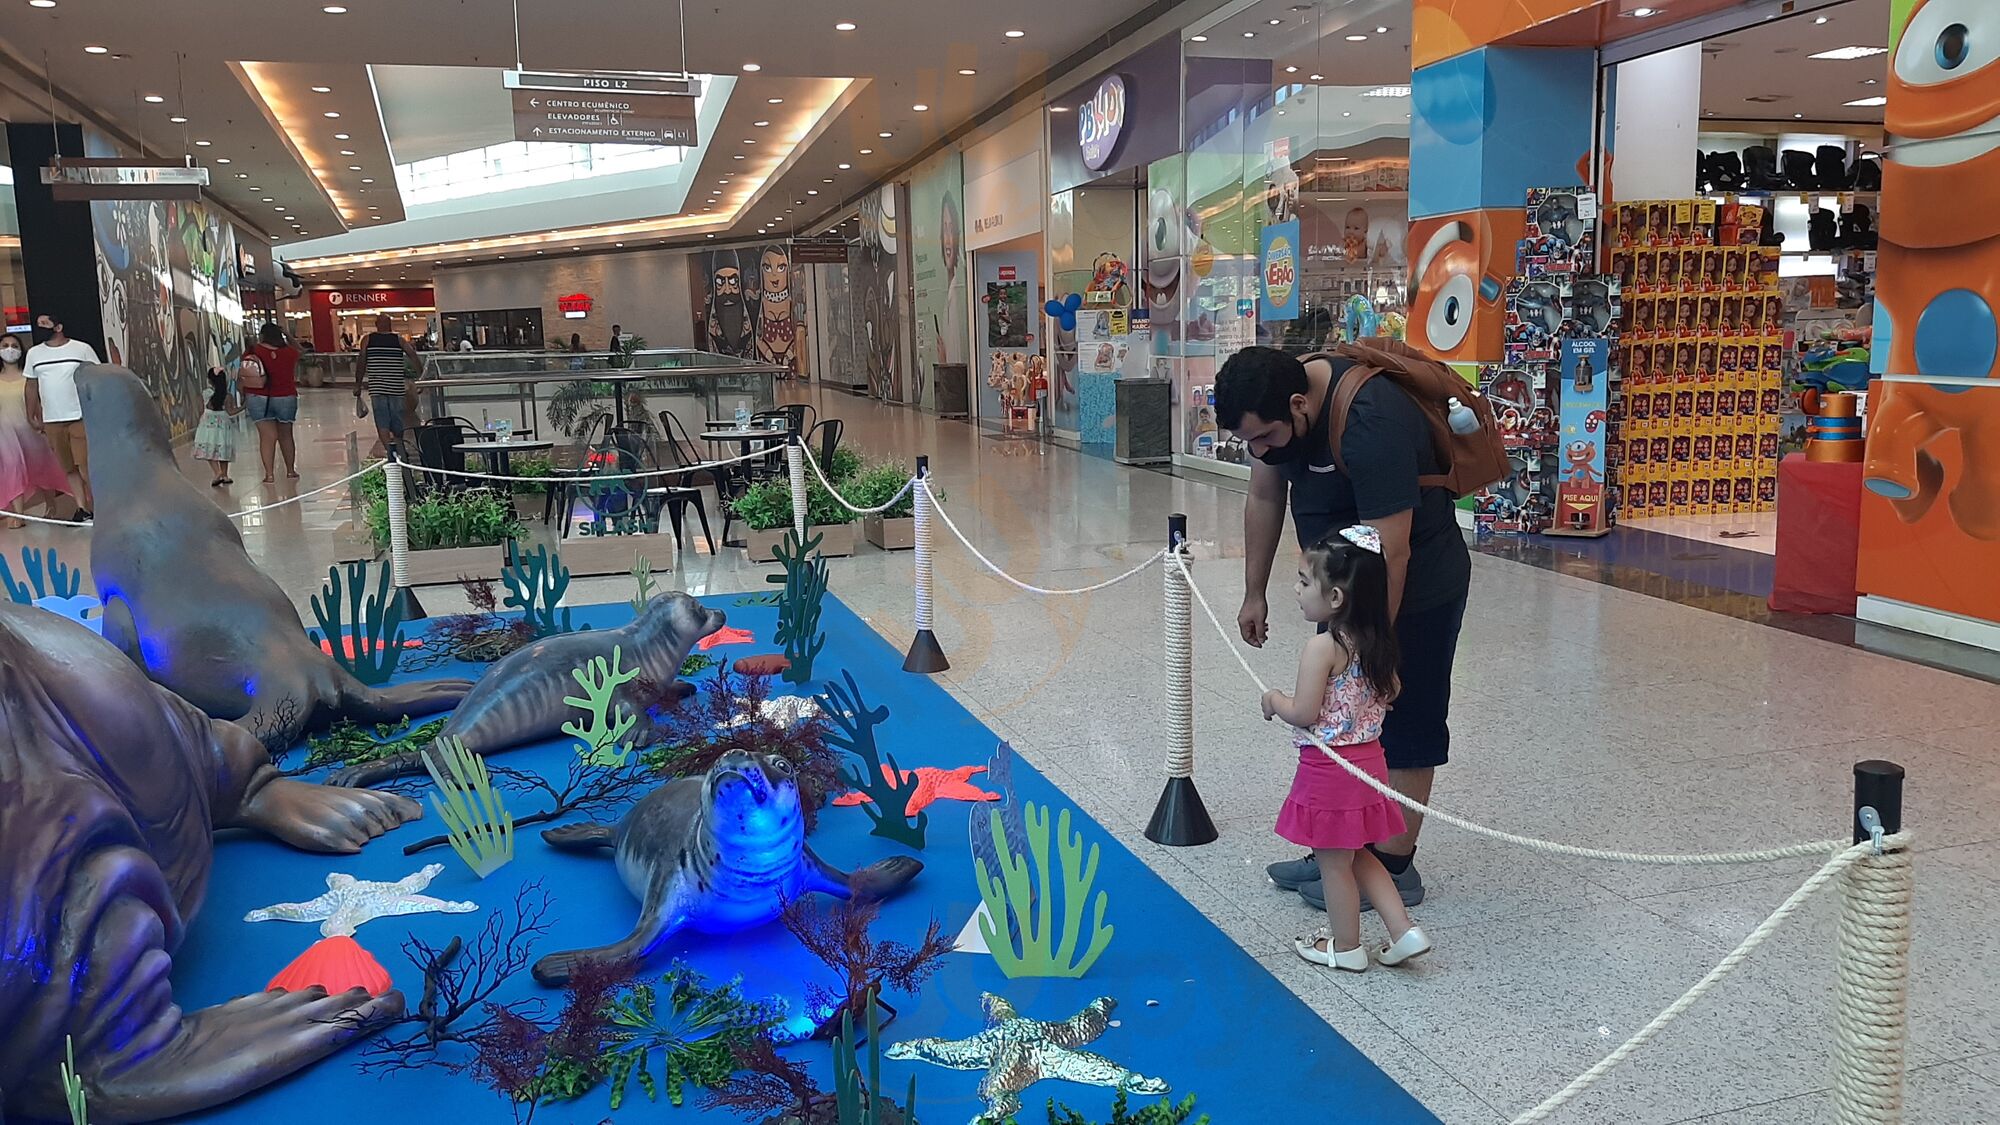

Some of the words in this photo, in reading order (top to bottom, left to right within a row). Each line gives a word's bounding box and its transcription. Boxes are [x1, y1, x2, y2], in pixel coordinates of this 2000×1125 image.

[583, 78, 610, 88] PISO
[615, 80, 628, 89] L2
[546, 100, 580, 108] CENTRO
[581, 101, 630, 110] ECUMÊNICO
[547, 113, 600, 121] ELEVADORES
[548, 127, 619, 136] ESTACIONAMENTO
[621, 129, 656, 138] EXTERNO
[1264, 258, 1295, 287] VERÃO
[345, 293, 388, 303] RENNER
[1562, 493, 1578, 502] PISE
[1579, 493, 1599, 502] AQUI
